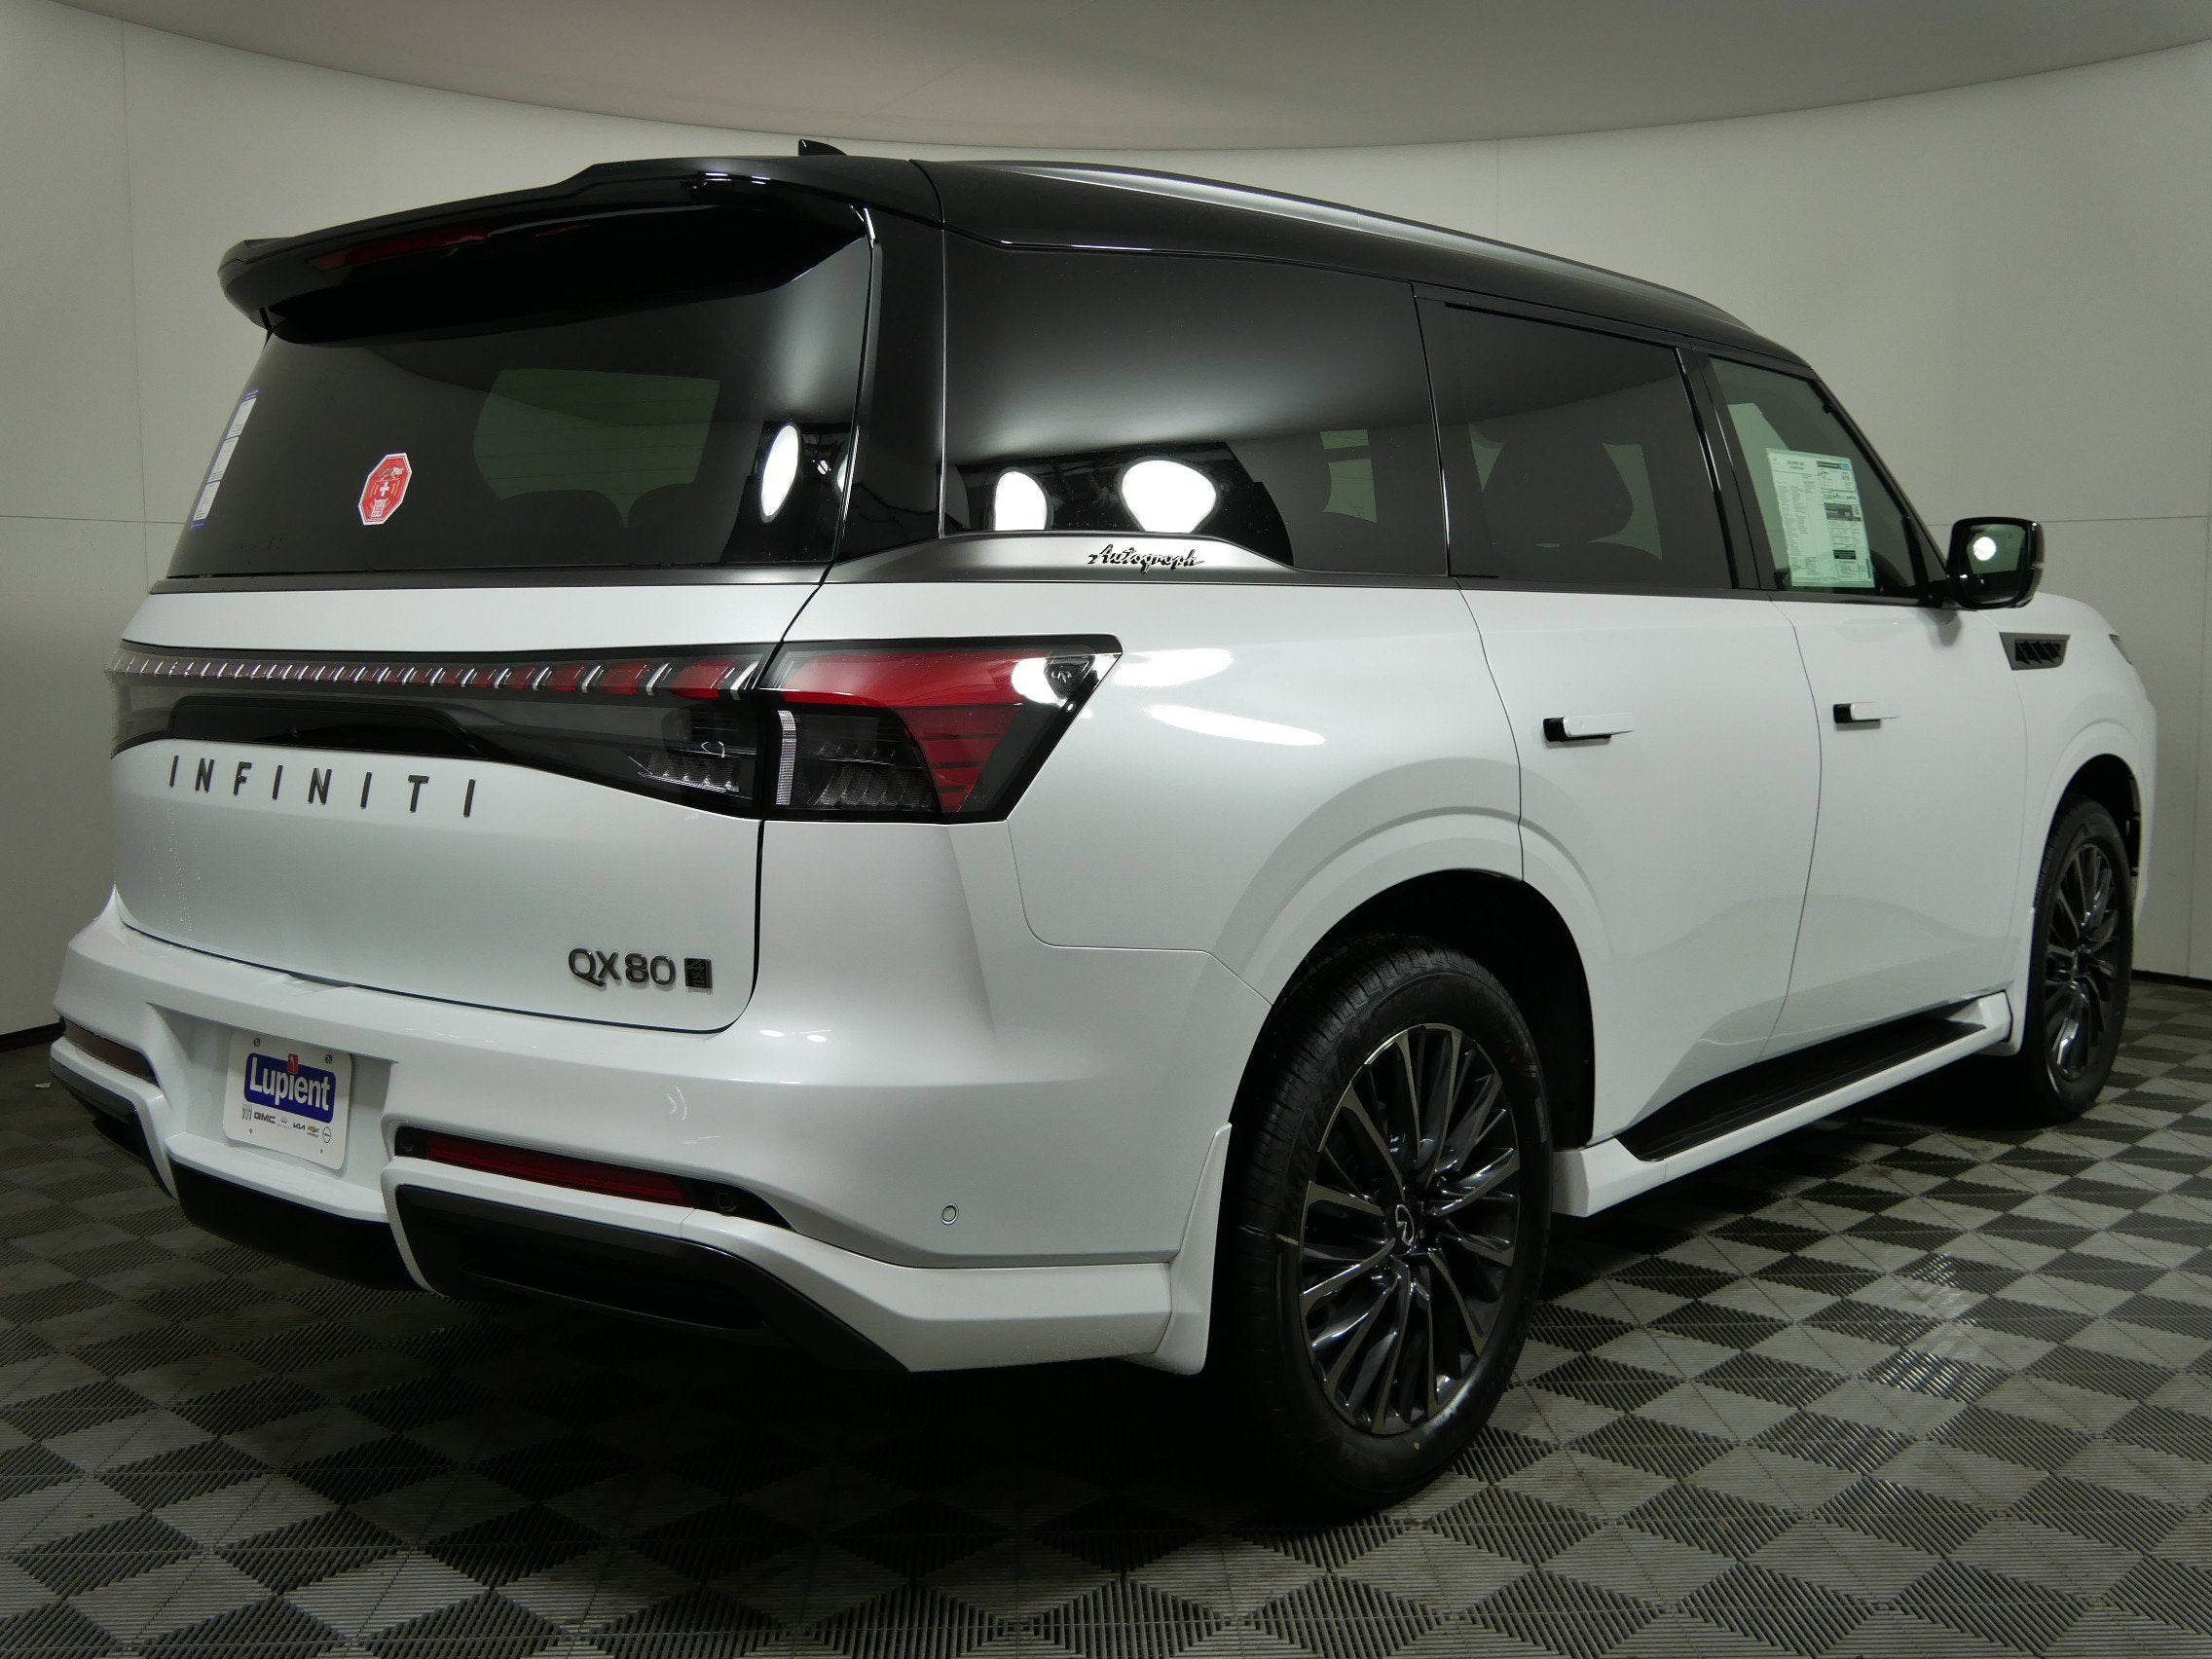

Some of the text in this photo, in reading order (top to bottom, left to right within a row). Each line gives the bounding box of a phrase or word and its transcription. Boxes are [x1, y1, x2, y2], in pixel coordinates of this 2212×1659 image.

[1087, 543, 1205, 574] Autograph
[168, 755, 476, 818] INFINITI
[568, 947, 677, 987] QX80
[249, 1056, 331, 1112] Lupient
[253, 1112, 276, 1124] GMC
